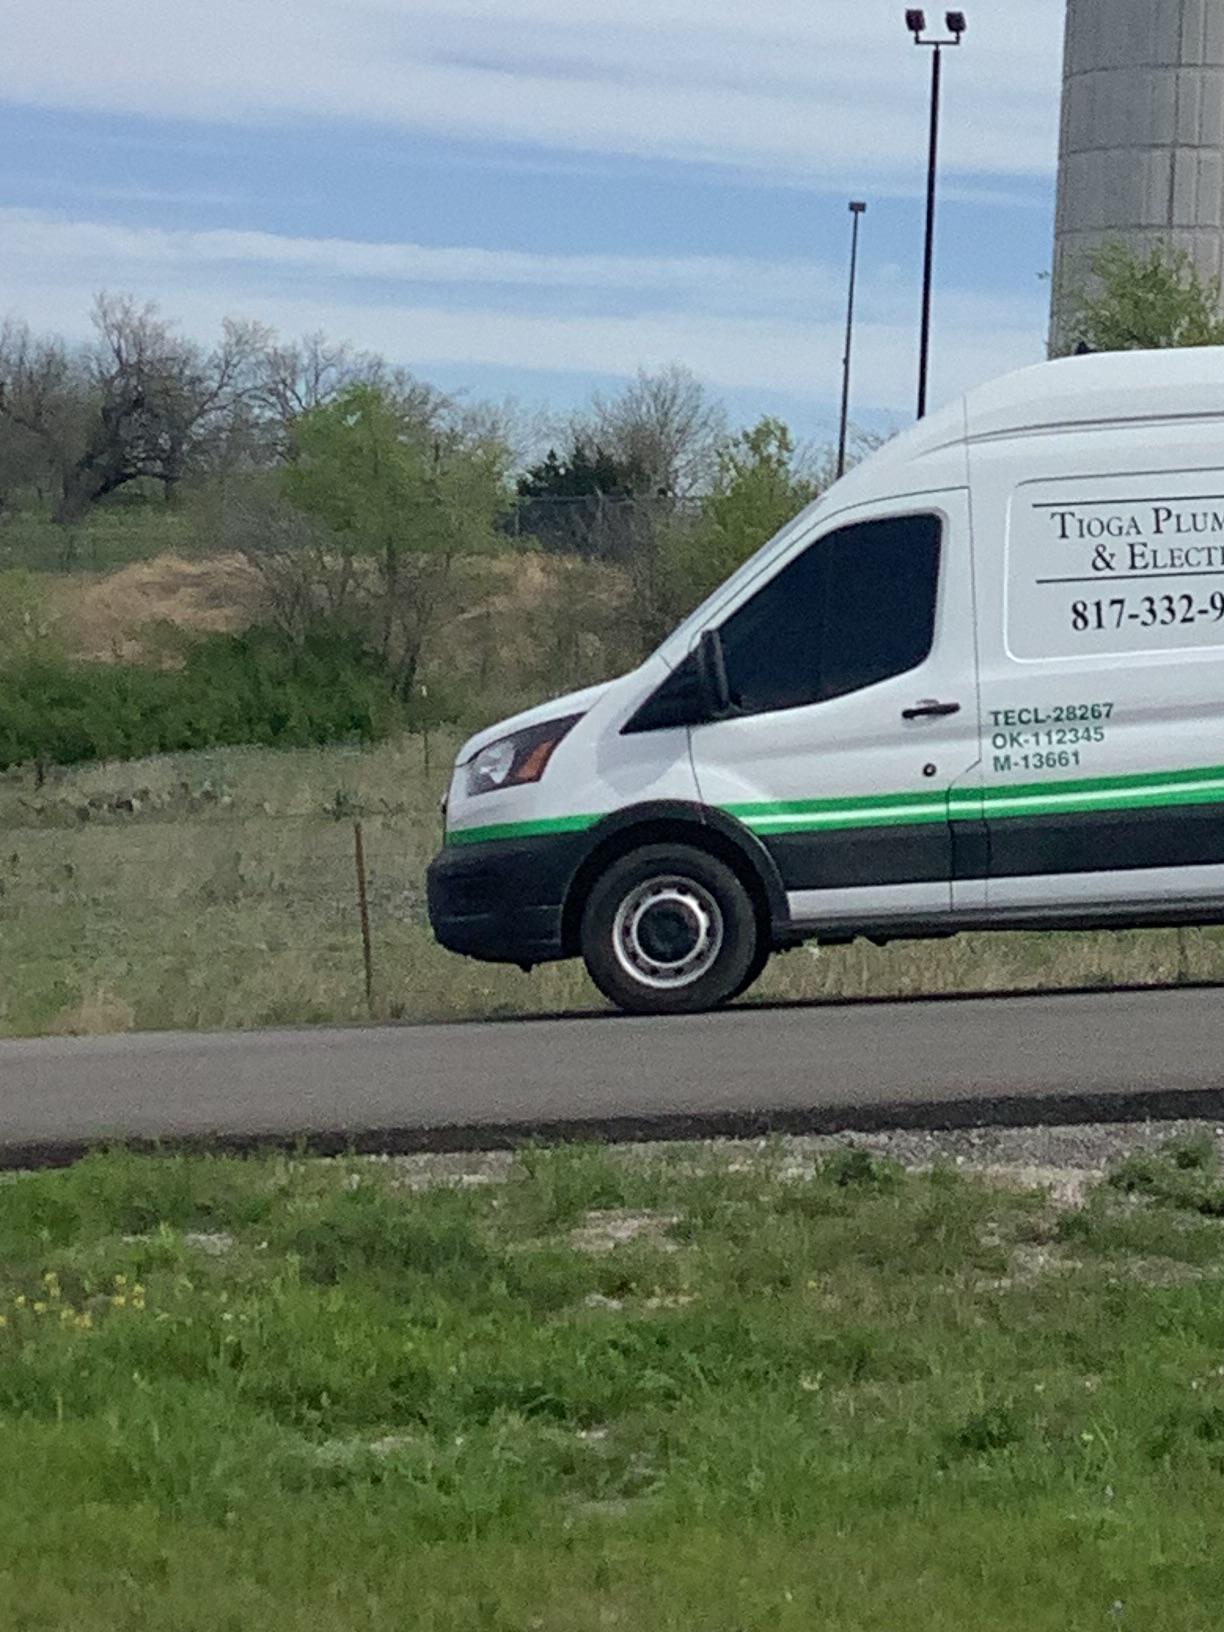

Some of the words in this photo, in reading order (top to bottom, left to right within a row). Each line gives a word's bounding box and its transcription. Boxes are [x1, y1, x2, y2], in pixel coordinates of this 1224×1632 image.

[1051, 511, 1143, 539] TIOGA
[1091, 543, 1116, 572] &
[990, 702, 1114, 726] TECL-28267
[992, 726, 1105, 749] OK-112345
[993, 749, 1080, 772] M-13661
